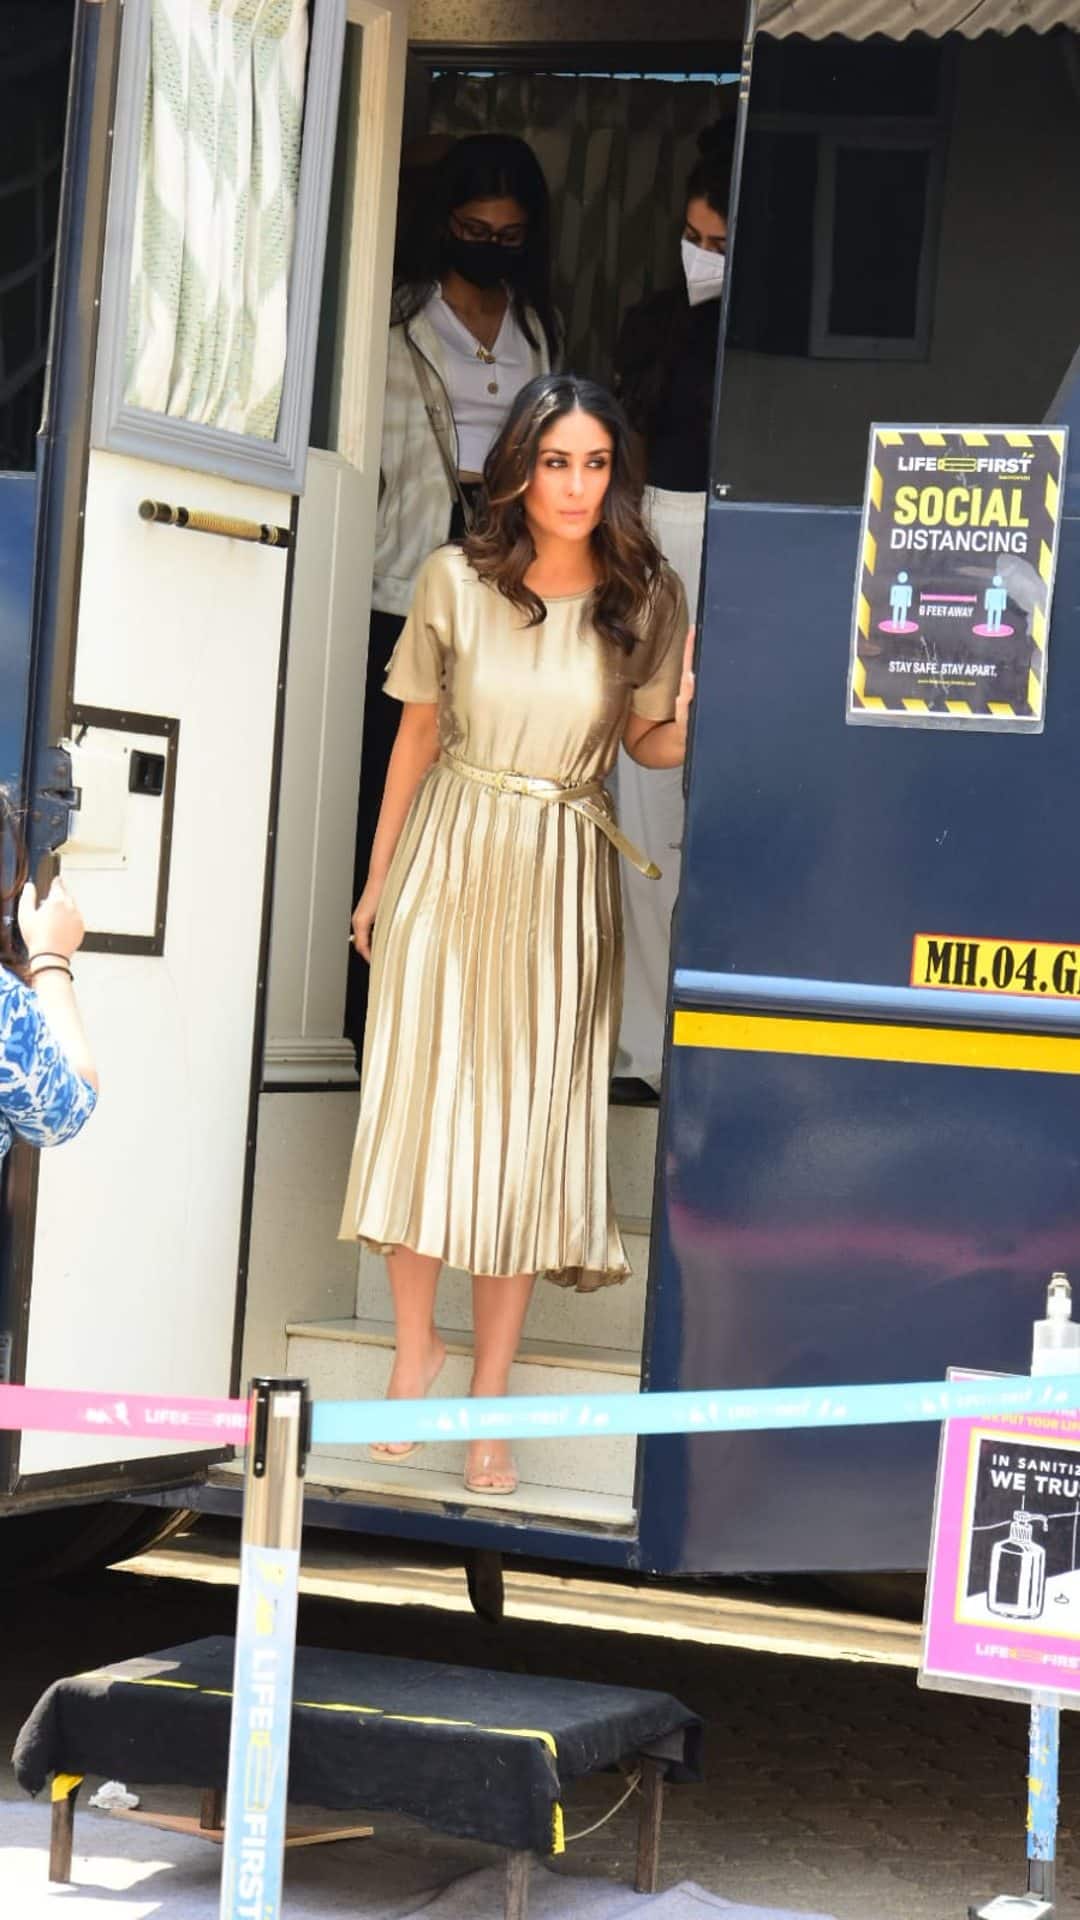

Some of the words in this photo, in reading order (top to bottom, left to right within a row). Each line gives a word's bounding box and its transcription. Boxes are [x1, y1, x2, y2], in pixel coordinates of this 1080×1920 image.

[898, 456, 937, 471] LIFE
[976, 457, 1032, 473] FIRST
[894, 485, 1030, 528] SOCIAL
[890, 528, 1028, 553] DISTANCING
[926, 606, 946, 616] FEET
[947, 607, 974, 617] AWAY
[889, 660, 912, 672] STAY
[940, 662, 964, 675] STAY
[924, 940, 1080, 995] MH.04.G
[992, 1453, 1010, 1467] IN
[1018, 1457, 1080, 1477] SANITIZ
[990, 1469, 1026, 1491] WE
[1034, 1475, 1080, 1498] TRU
[249, 1649, 278, 1730] LIFE
[237, 1812, 268, 1920] FIRST
